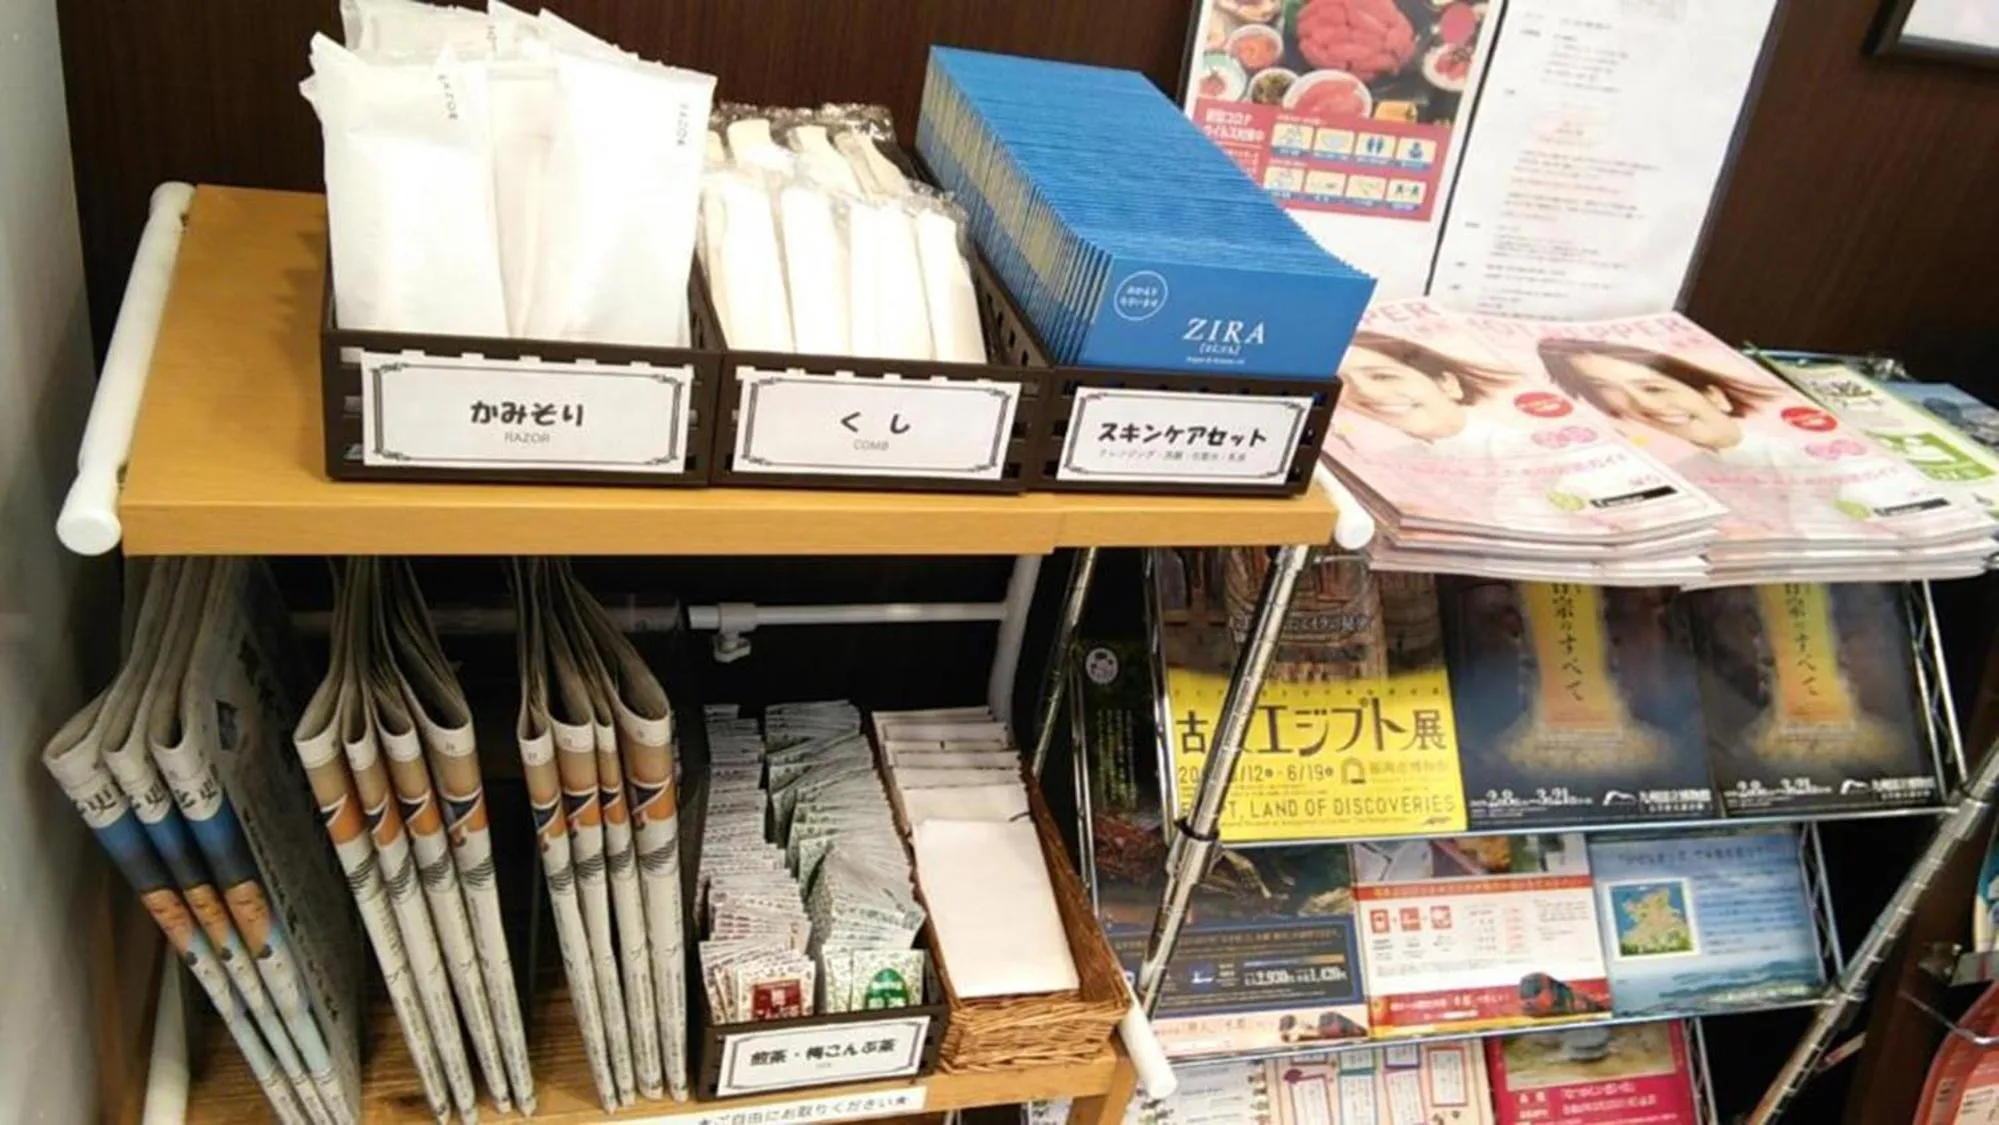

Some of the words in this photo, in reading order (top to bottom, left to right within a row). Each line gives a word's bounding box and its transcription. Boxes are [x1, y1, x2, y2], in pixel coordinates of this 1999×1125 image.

[1182, 317, 1265, 345] ZIRA
[470, 400, 584, 427] かみそり
[504, 431, 551, 444] RAZOR
[853, 439, 889, 452] COMB
[1097, 422, 1268, 448] スキンケアセット
[1176, 697, 1447, 756] 古エジプト展
[1250, 799, 1298, 819] LAND
[1304, 798, 1328, 817] OF
[1333, 793, 1456, 817] DISCOVERIES
[751, 1038, 897, 1067] 煎茶・梅こんぶ茶
